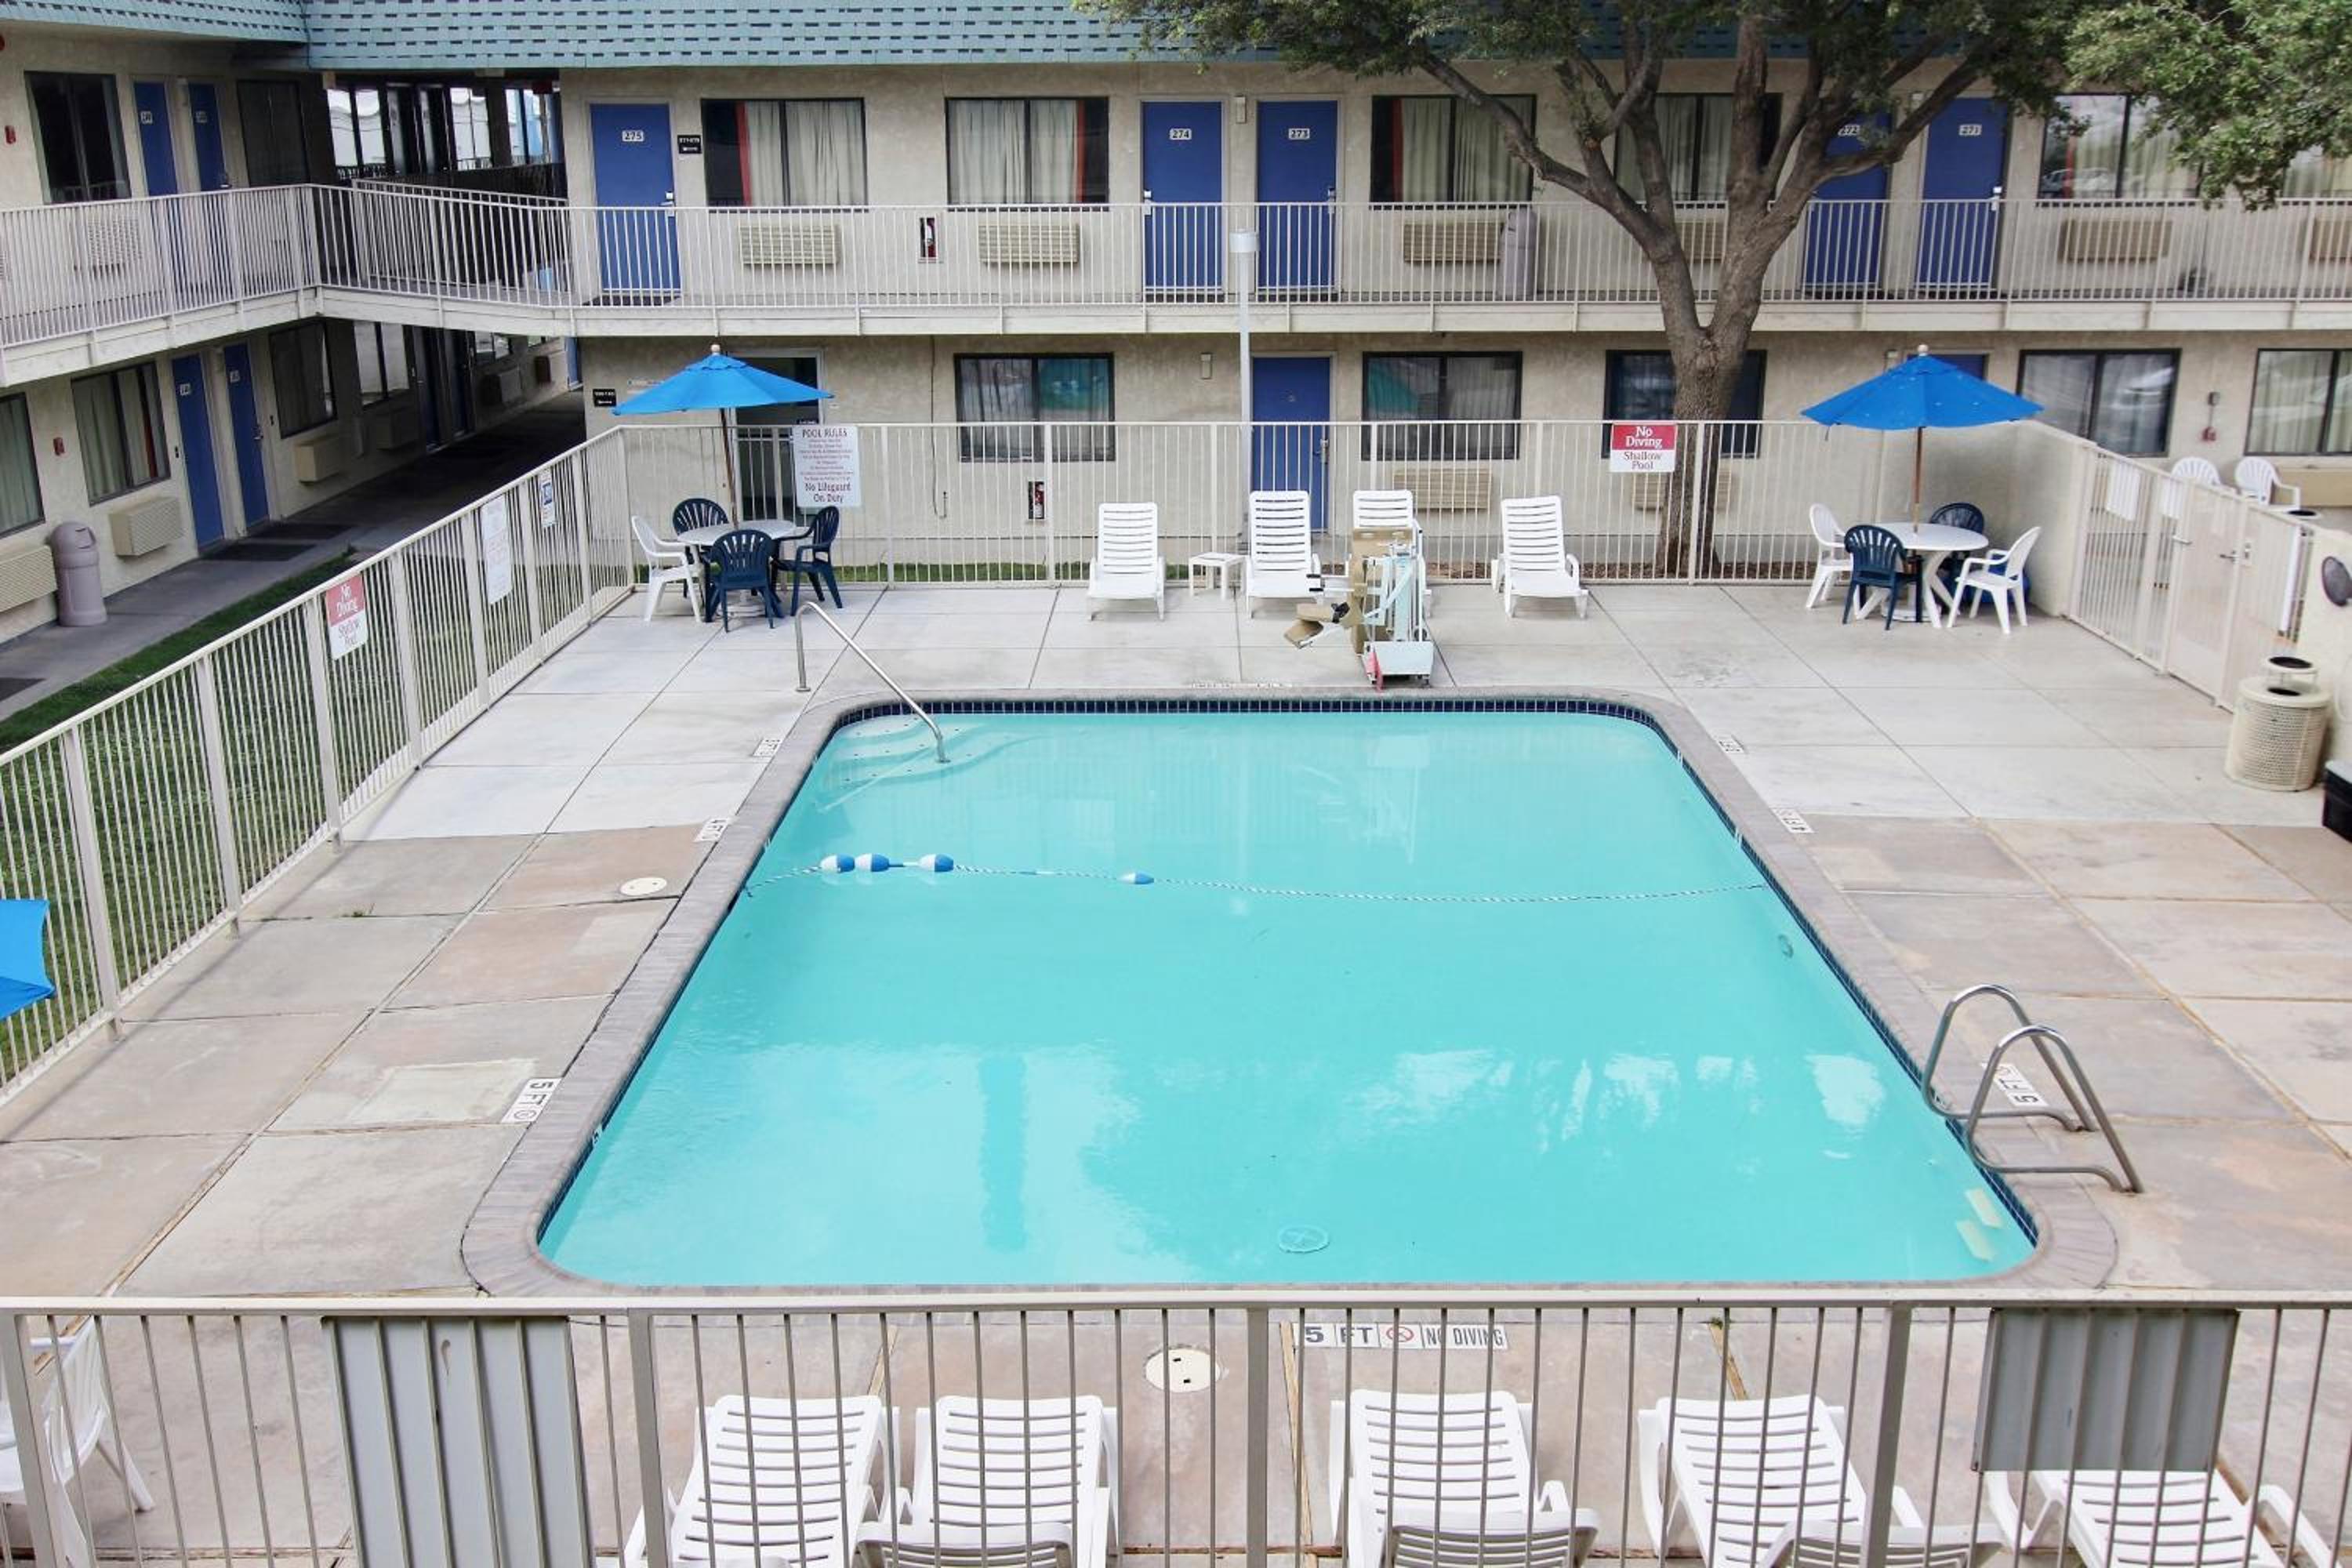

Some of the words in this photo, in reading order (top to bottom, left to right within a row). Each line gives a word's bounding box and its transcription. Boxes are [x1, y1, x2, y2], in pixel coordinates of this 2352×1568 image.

[625, 131, 641, 140] 275
[802, 429, 822, 437] POOL
[824, 428, 848, 437] RULES
[1635, 426, 1653, 437] No
[1625, 436, 1663, 449] Diving
[1624, 451, 1661, 461] Shallow
[1632, 461, 1653, 470] Pool
[805, 483, 816, 492] No
[818, 482, 851, 492] Lifeguard
[813, 494, 825, 503] On
[827, 494, 843, 503] Duty
[1998, 1078, 2030, 1091] FT
[517, 1094, 547, 1105] FT
[1305, 1327, 1324, 1343] 5
[1341, 1327, 1373, 1344] FT
[1454, 1327, 1504, 1346] DIVING
